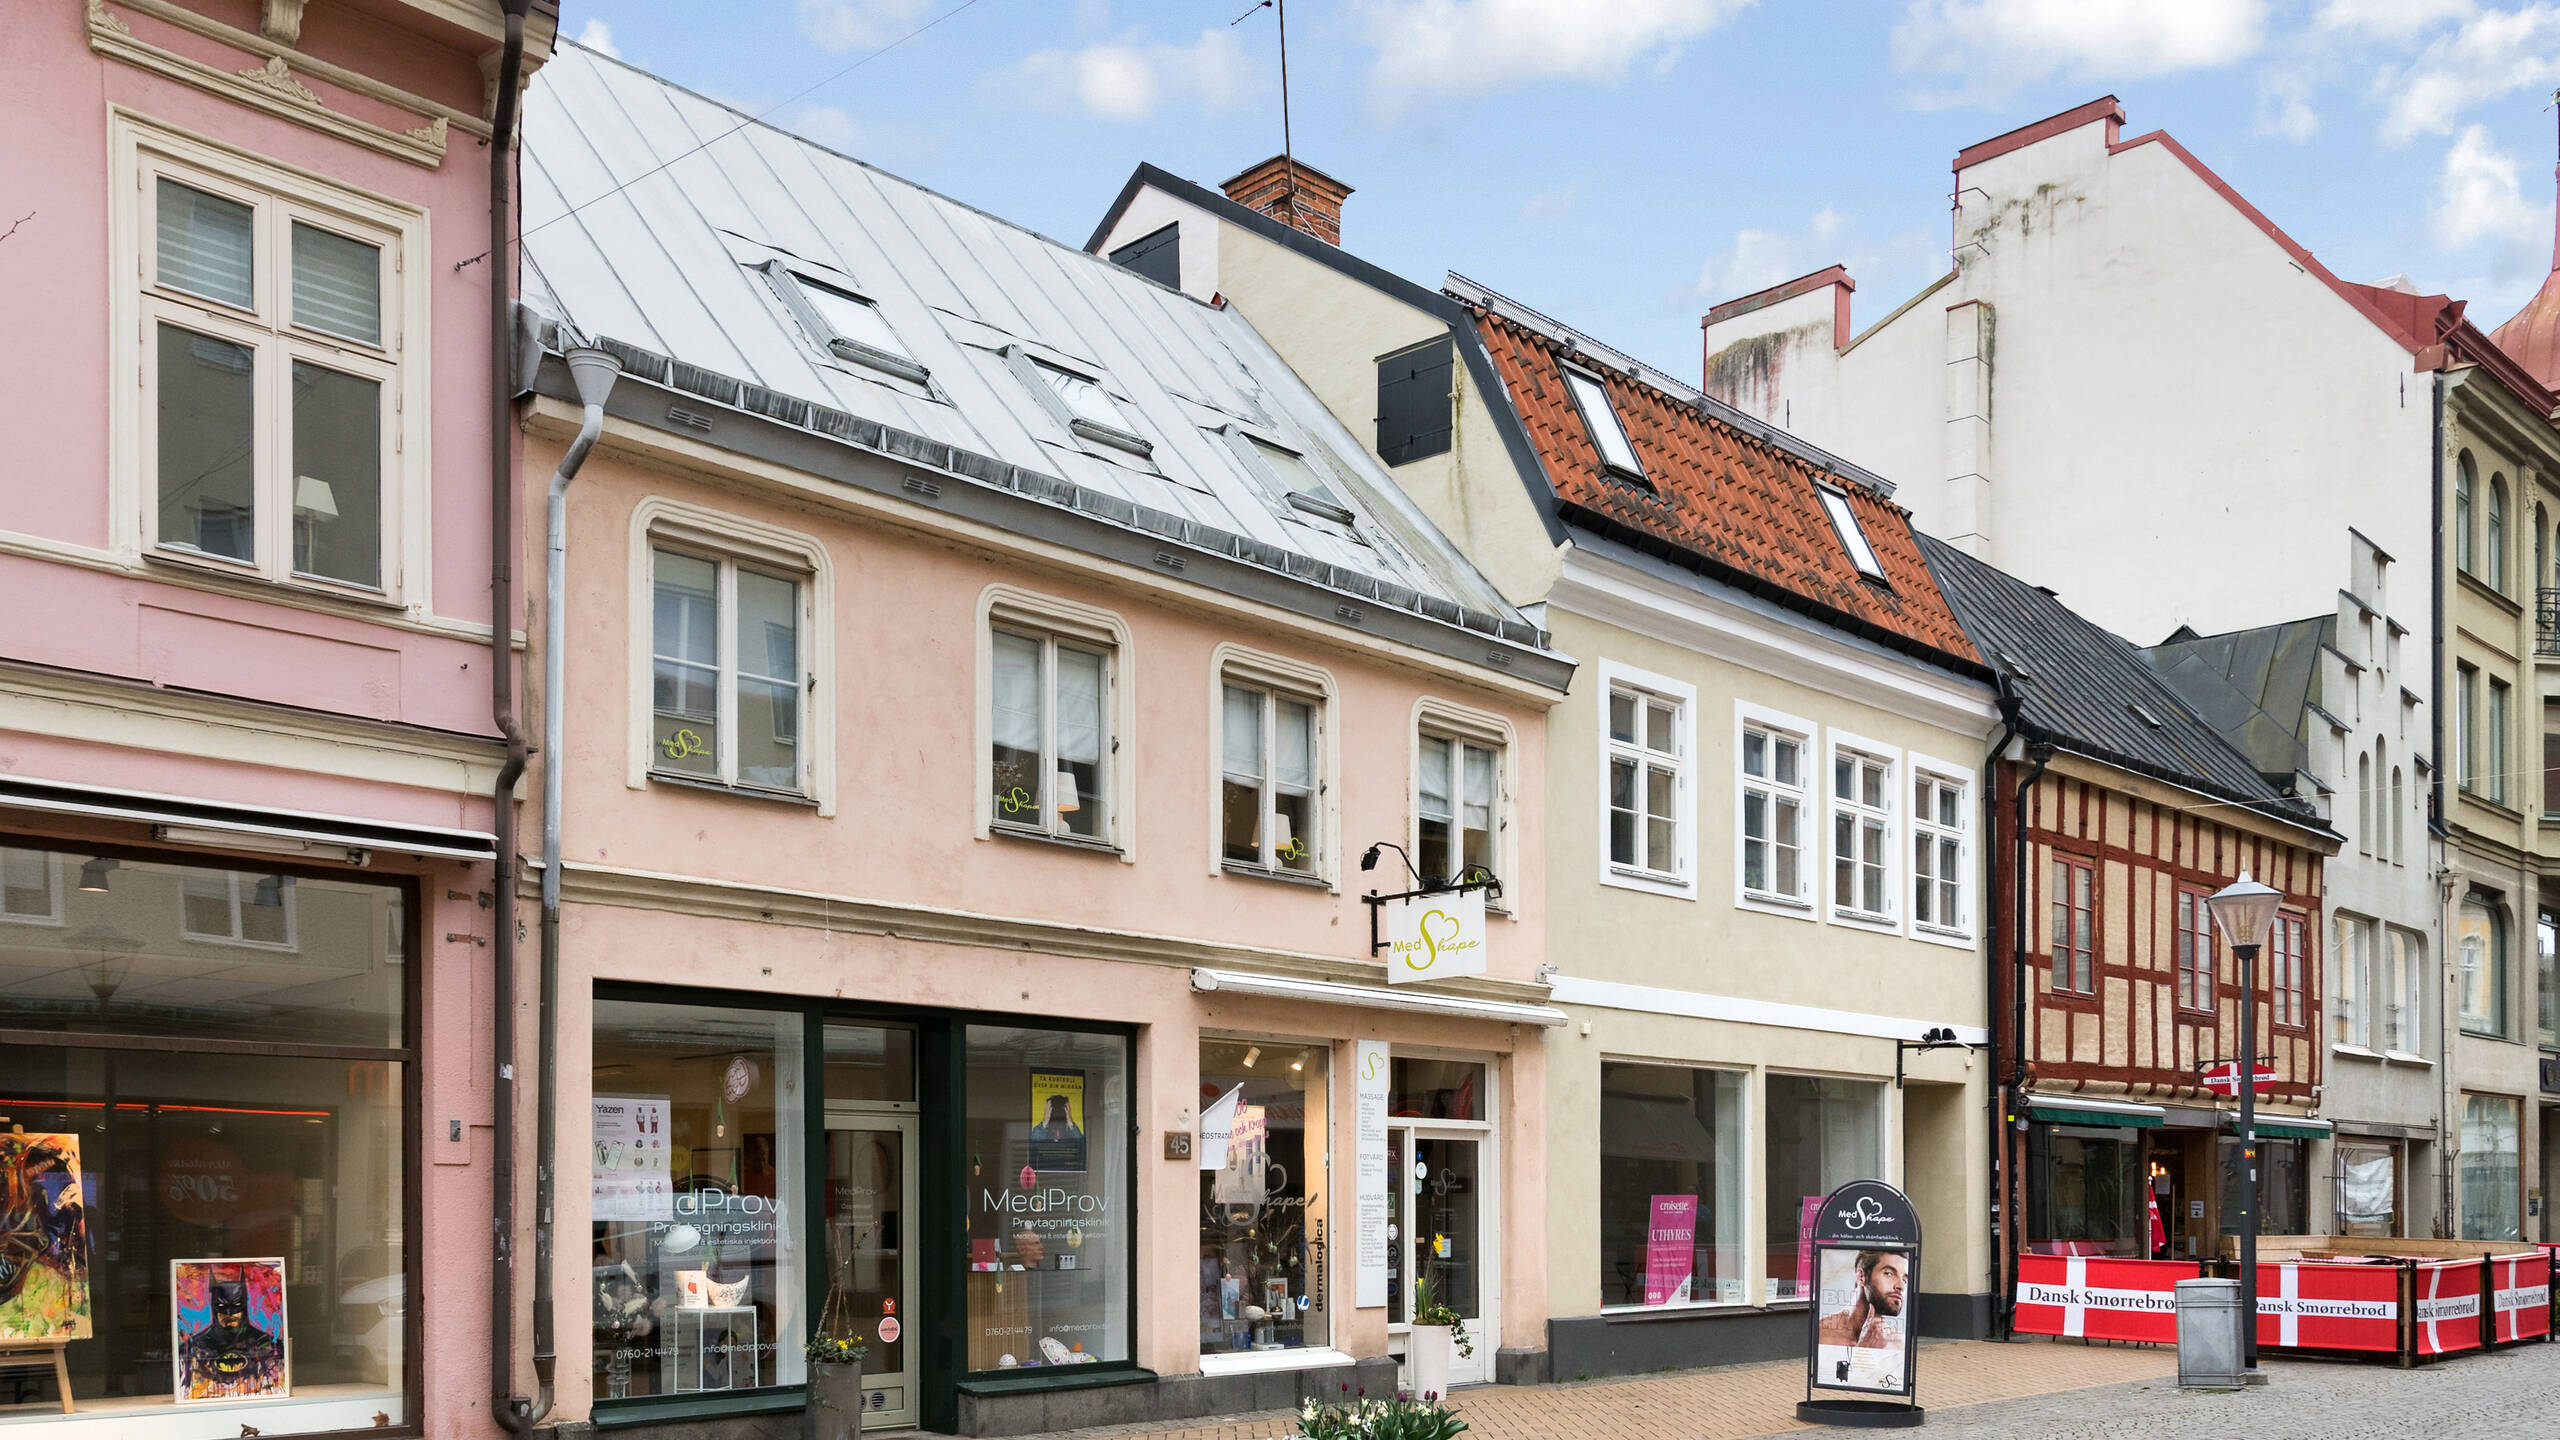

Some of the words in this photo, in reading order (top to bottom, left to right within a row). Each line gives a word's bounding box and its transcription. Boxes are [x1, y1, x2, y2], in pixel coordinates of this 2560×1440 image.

[596, 1104, 624, 1113] Yazen
[1170, 1135, 1190, 1154] 45
[984, 1188, 1110, 1212] MedProv
[1651, 1228, 1692, 1242] UTHYRES
[1315, 1218, 1326, 1313] dermalogica
[2029, 1287, 2079, 1303] Dansk
[2084, 1291, 2175, 1310] Smørrebrø
[2297, 1301, 2387, 1316] Smørrebrød
